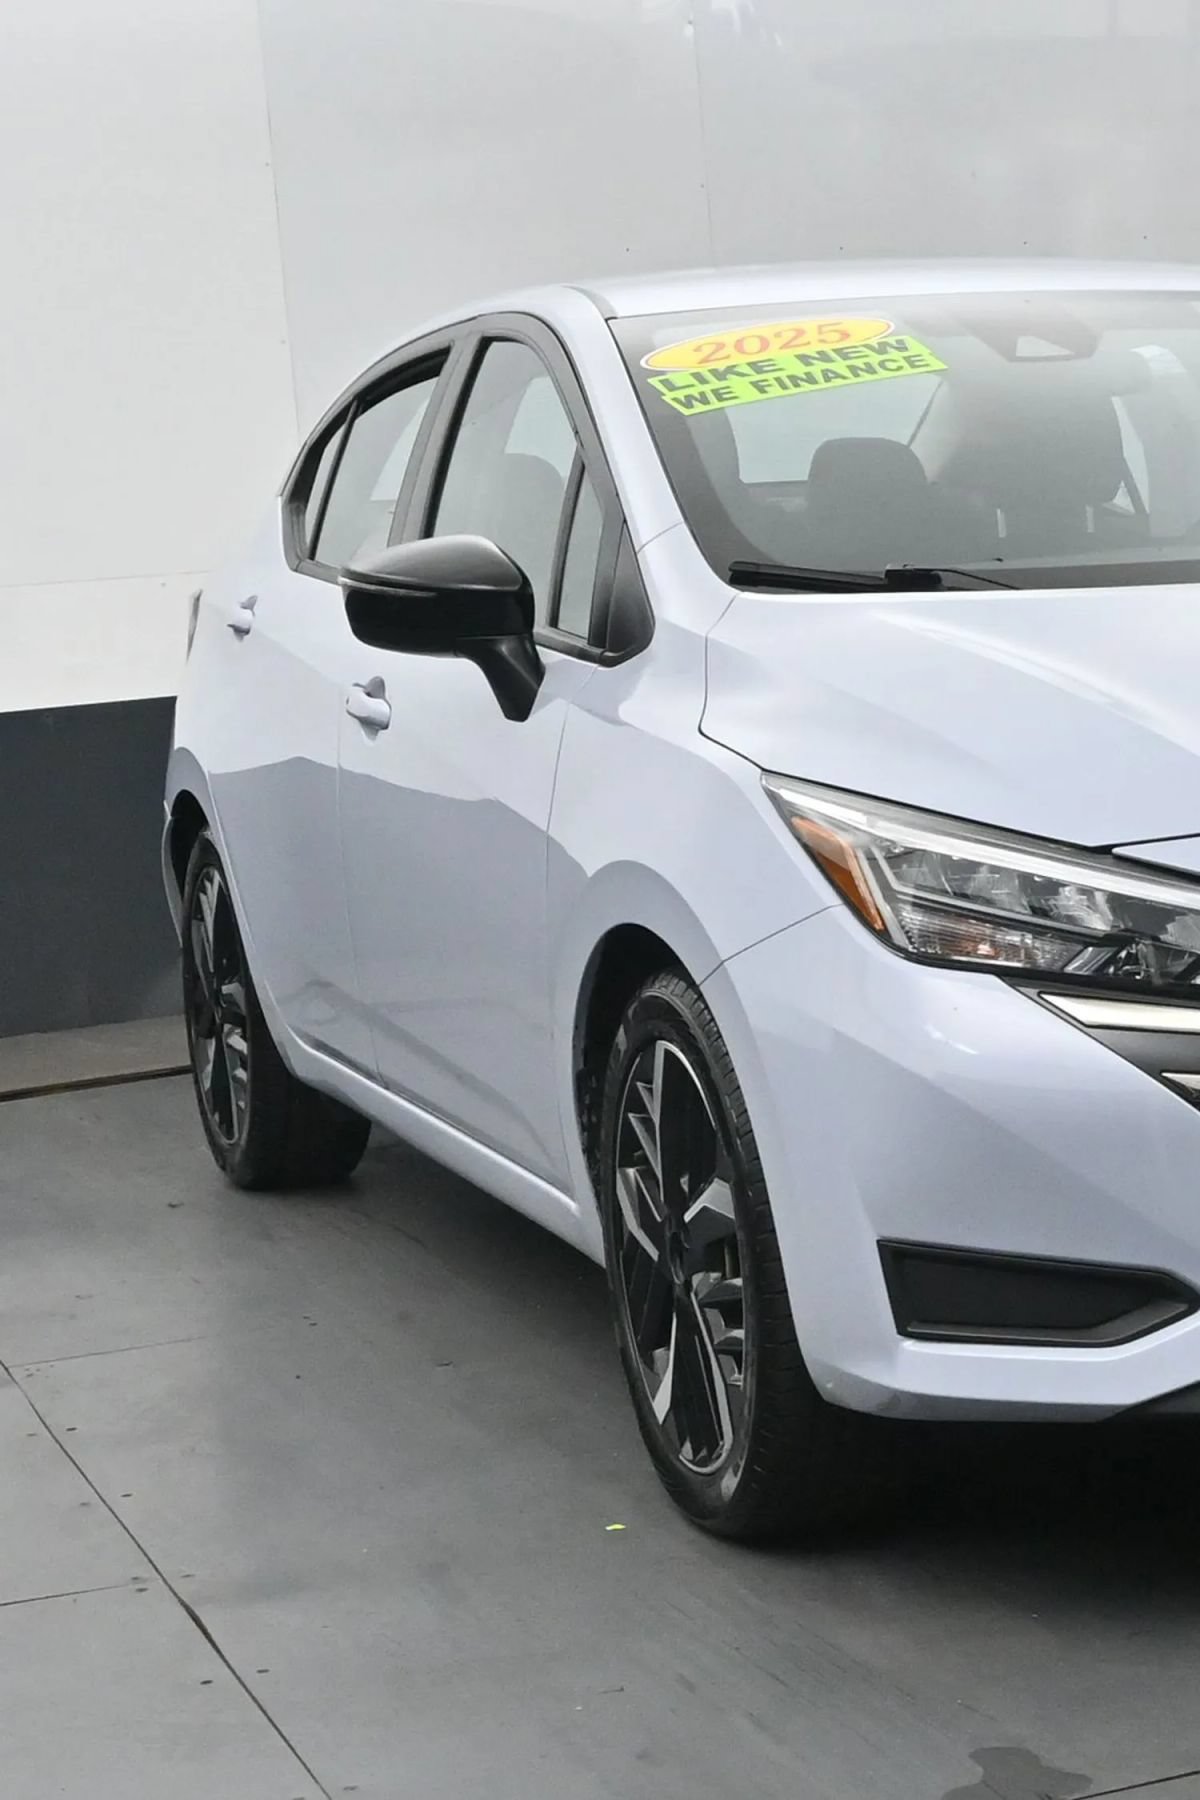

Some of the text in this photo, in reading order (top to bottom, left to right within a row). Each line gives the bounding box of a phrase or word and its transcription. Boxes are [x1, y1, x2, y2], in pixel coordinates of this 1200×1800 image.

[659, 338, 909, 392] LIKE NEW
[694, 321, 851, 365] 2025
[671, 353, 931, 410] WE FINANCE
